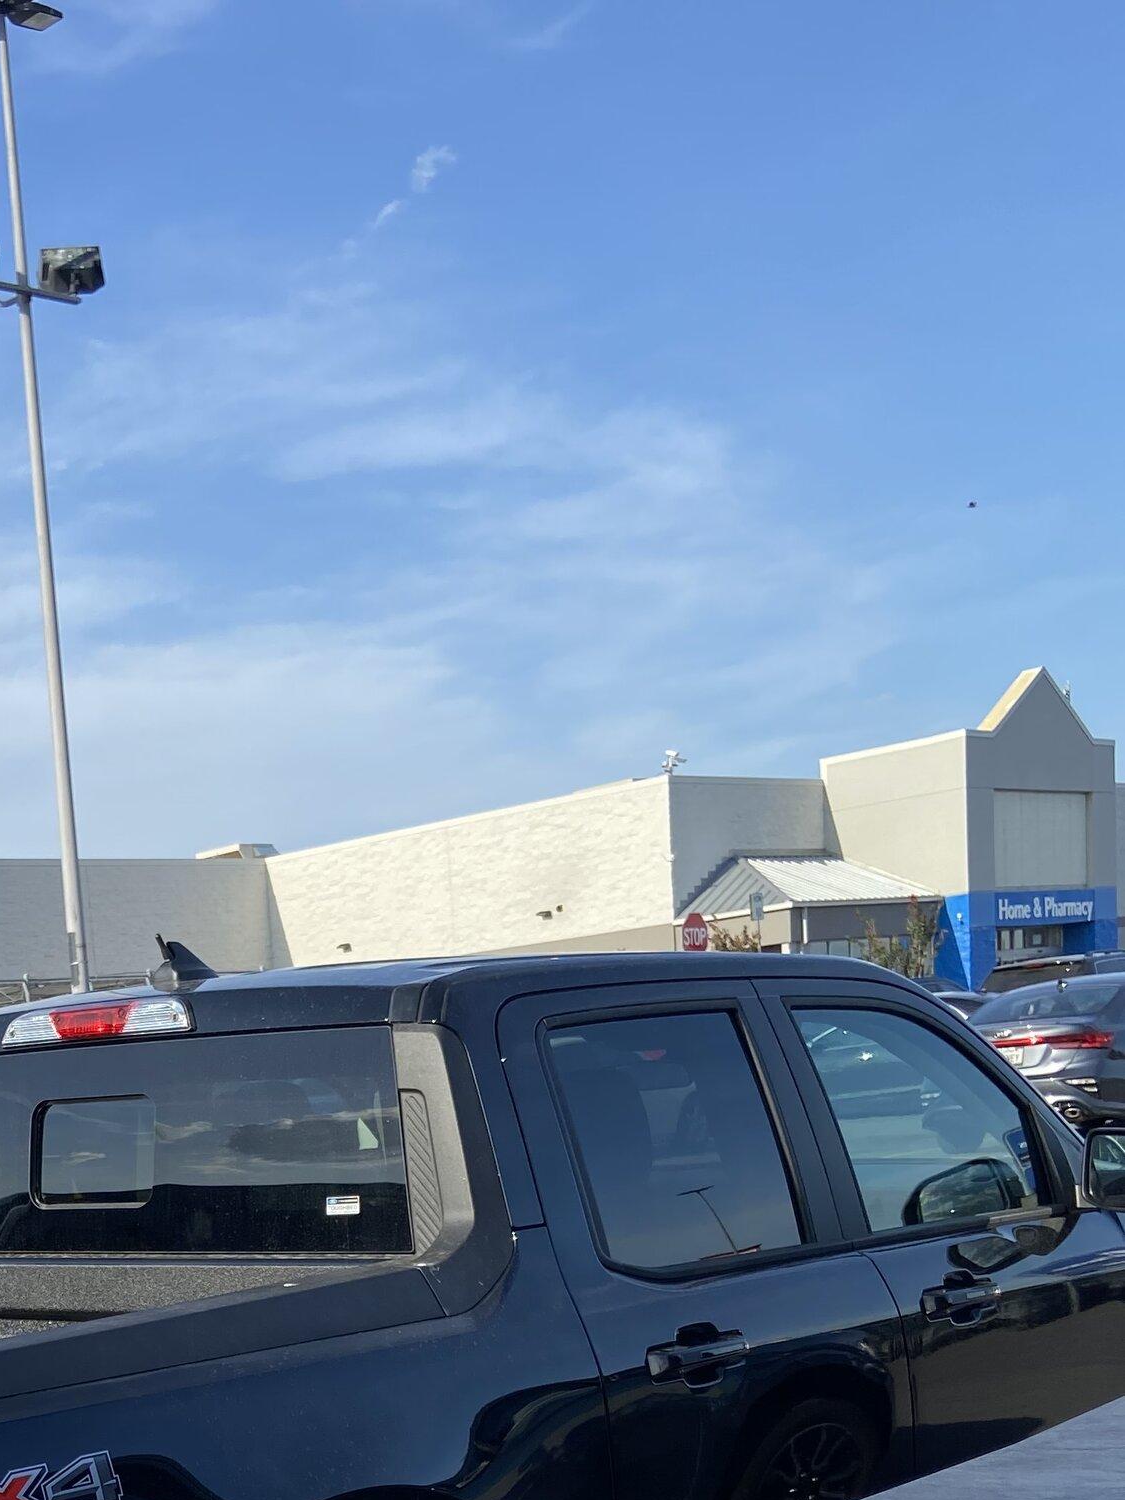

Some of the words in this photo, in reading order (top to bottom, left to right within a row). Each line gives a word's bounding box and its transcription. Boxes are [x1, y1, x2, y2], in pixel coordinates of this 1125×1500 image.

[998, 898, 1032, 921] Home
[1033, 897, 1043, 918] &
[1044, 897, 1094, 922] Pharmacy
[683, 927, 707, 946] STOP
